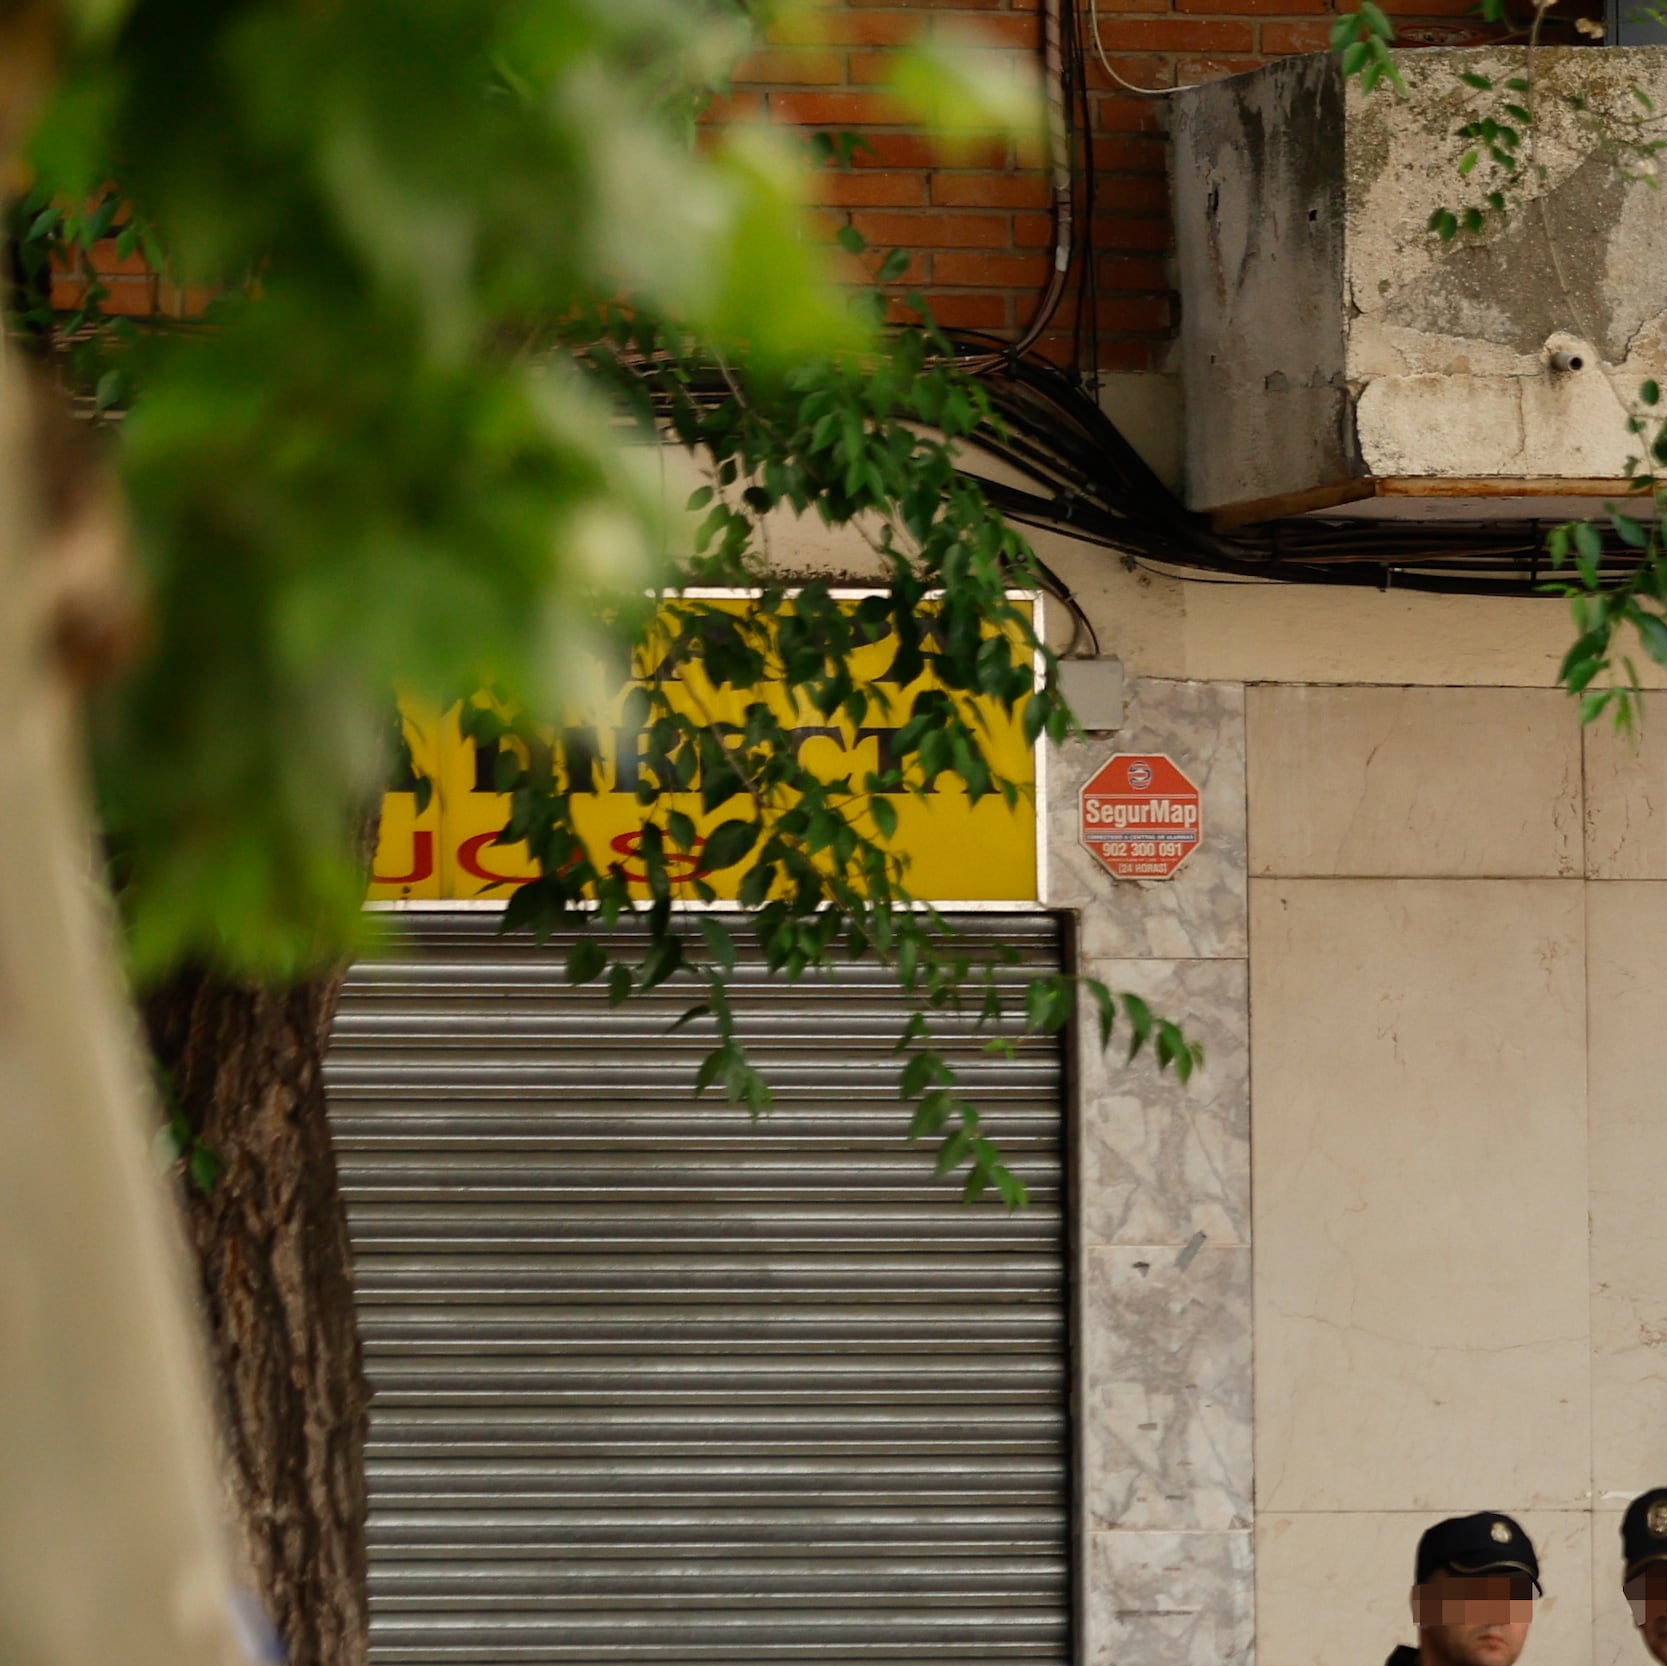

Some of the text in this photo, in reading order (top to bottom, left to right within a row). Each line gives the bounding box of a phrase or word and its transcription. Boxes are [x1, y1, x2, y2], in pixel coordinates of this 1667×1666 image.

[1085, 799, 1197, 829] SegurMap
[1103, 843, 1183, 857] 902 300 091
